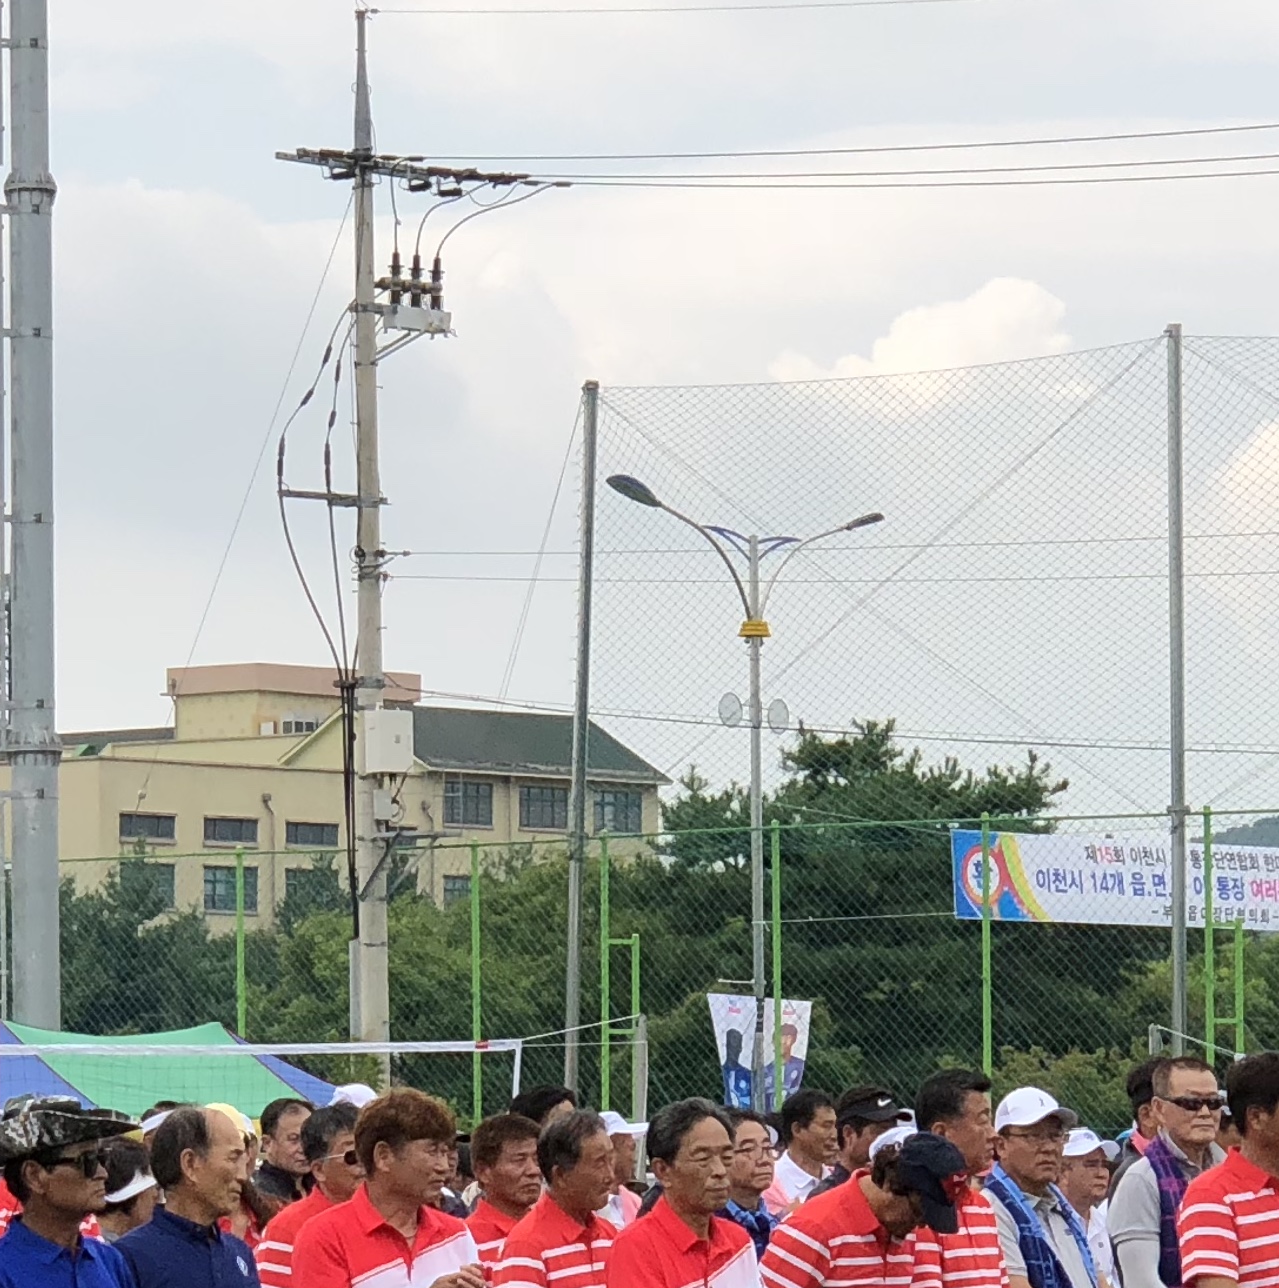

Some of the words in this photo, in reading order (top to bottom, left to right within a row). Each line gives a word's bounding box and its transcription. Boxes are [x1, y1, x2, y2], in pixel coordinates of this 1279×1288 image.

[1084, 844, 1126, 866] 제15회
[1129, 845, 1168, 867] 이천시
[1035, 868, 1085, 895] 이천시
[1090, 871, 1126, 897] 14개
